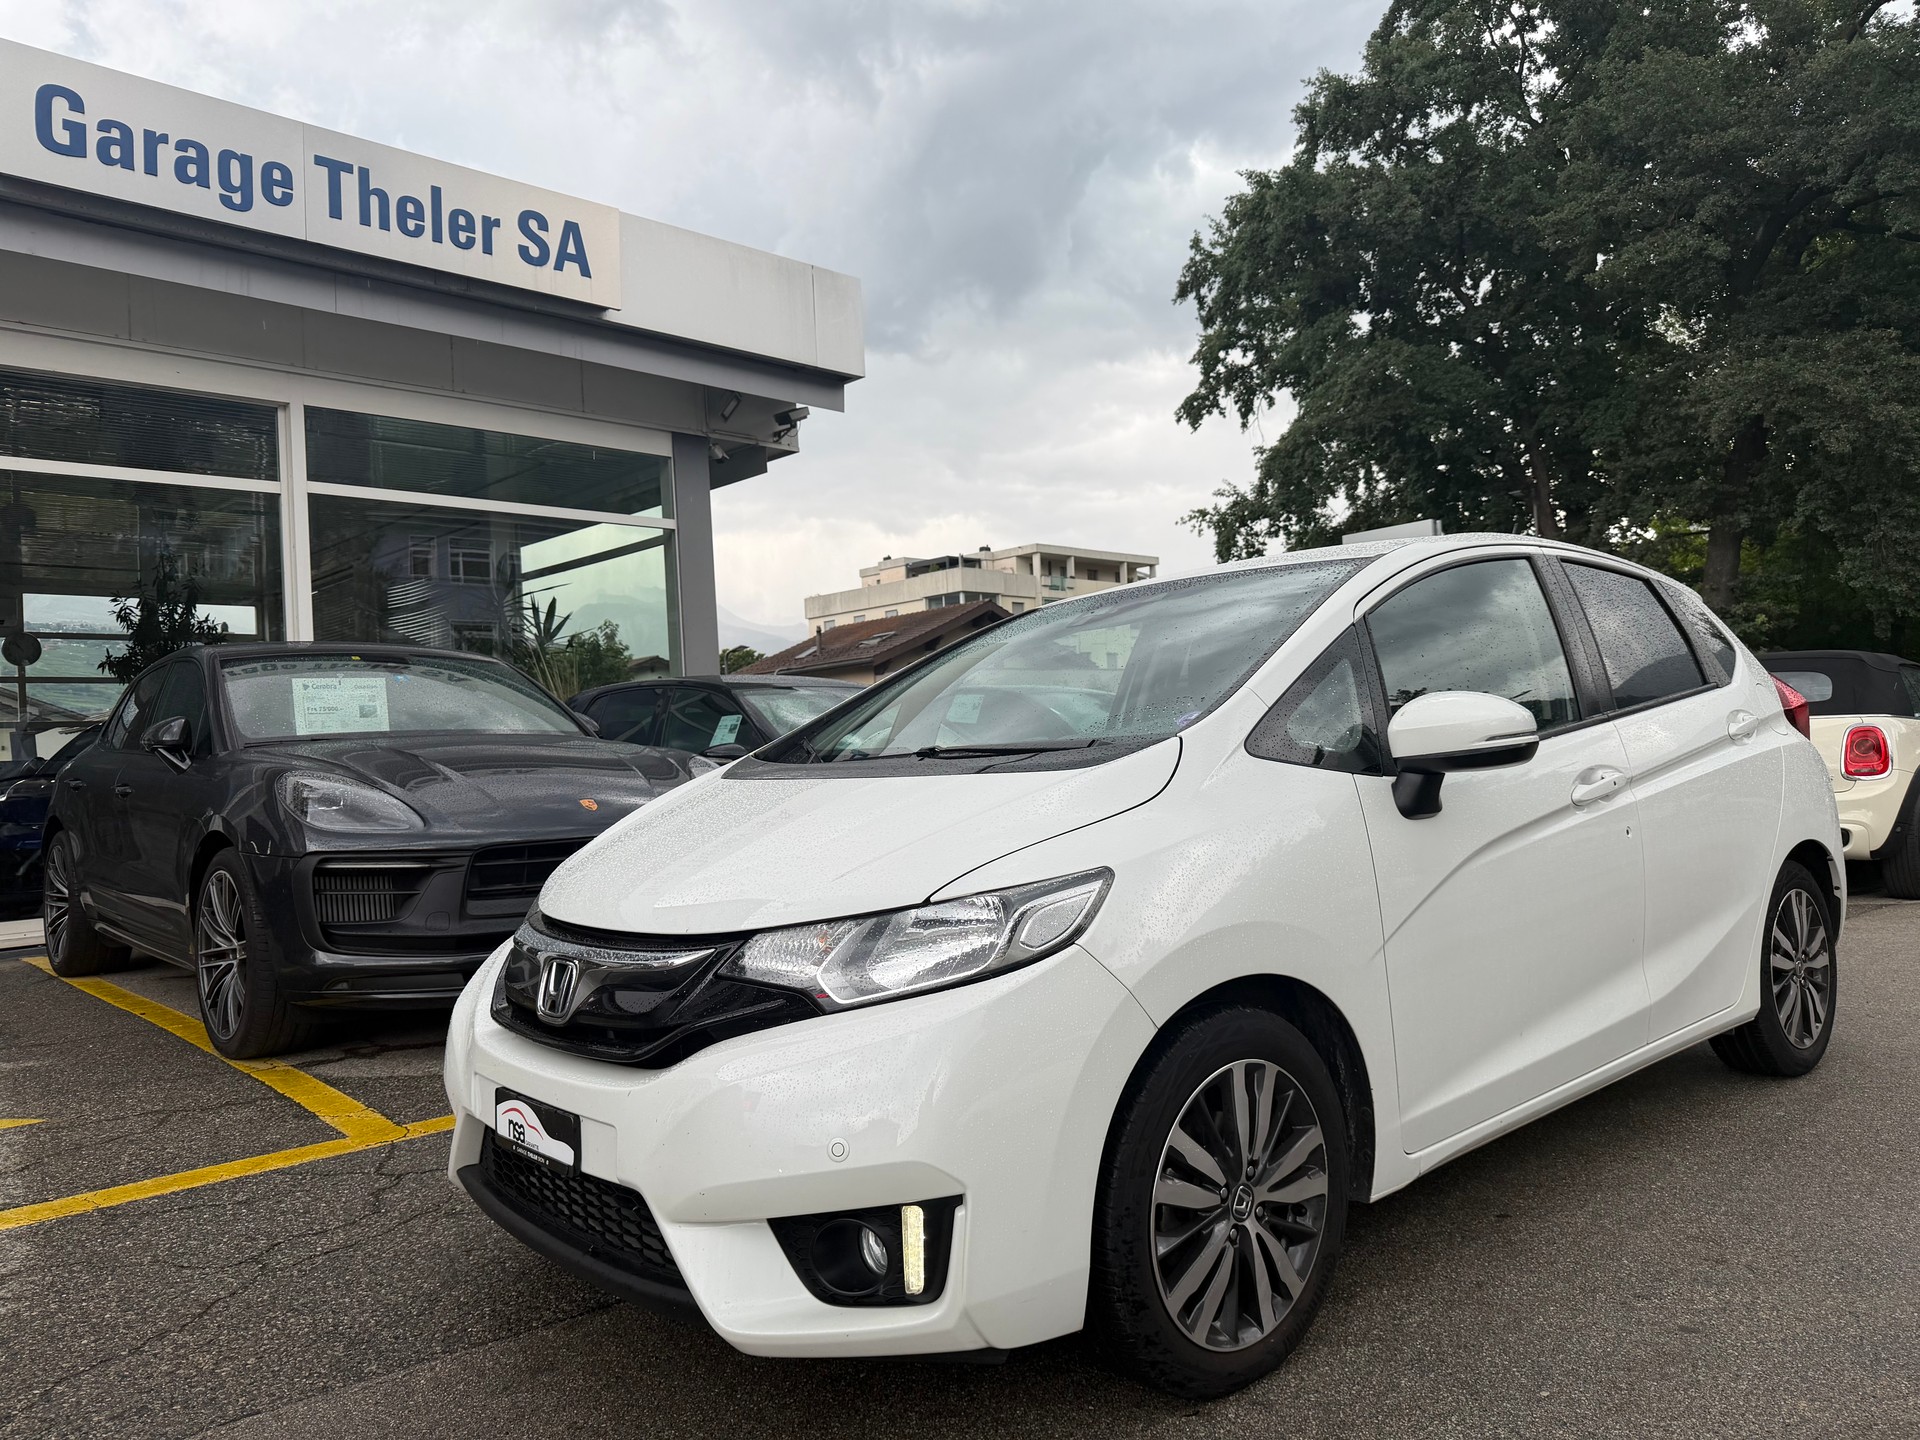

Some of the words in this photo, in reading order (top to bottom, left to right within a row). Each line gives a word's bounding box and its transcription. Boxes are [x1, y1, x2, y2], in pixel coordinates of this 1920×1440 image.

[34, 83, 295, 213] Garage
[313, 154, 501, 256] Theler
[517, 209, 592, 280] SA
[508, 1118, 526, 1145] nsa
